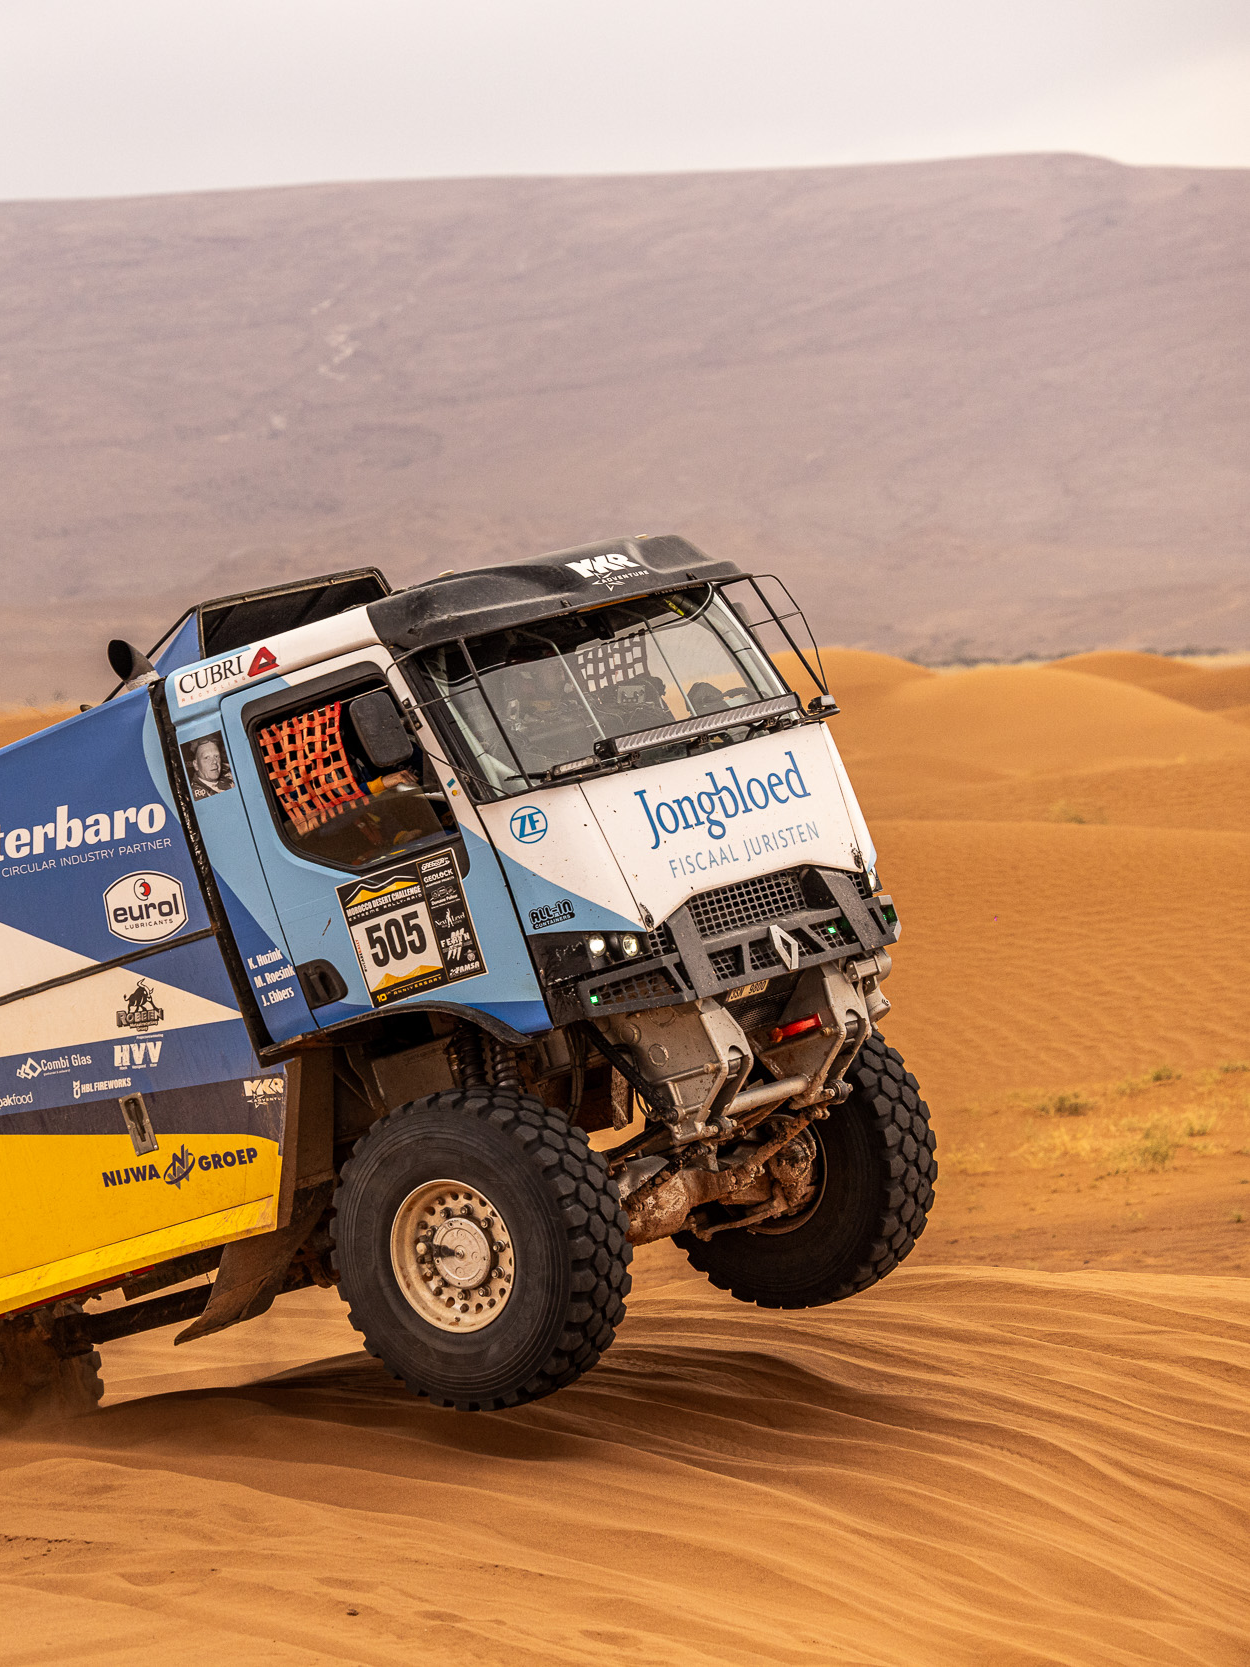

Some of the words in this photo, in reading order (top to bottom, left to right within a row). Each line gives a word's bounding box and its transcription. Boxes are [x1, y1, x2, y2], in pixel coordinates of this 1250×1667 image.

[564, 553, 640, 578] MKR
[602, 570, 650, 584] ADVENTURE
[179, 654, 244, 694] CUBRI
[182, 676, 246, 702] RECYCLING
[634, 751, 812, 850] Jongbloed
[511, 810, 546, 838] ZF
[2, 858, 56, 878] CIRCULAR
[60, 848, 115, 867] INDUSTRY
[118, 838, 172, 856] PARTNER
[668, 844, 739, 878] FISCAAL
[743, 821, 820, 862] JURISTEN
[424, 868, 454, 883] GEOLOCK
[112, 893, 180, 924] eurol
[346, 903, 372, 918] MOROCCO
[372, 895, 392, 910] DESERT
[391, 884, 422, 900] CHALLENGE
[530, 900, 574, 924] ALL-IN
[124, 918, 174, 930] LUBRICANTS
[533, 913, 574, 930] CONTAINERS
[364, 910, 427, 968] 505
[247, 958, 258, 970] K.
[256, 948, 284, 967] Huzink
[254, 976, 266, 988] M.
[264, 964, 296, 984] Roesink
[394, 976, 442, 995] ANNIVERSARY
[261, 994, 270, 1006] J.
[268, 986, 294, 1004] Ebbers
[116, 1008, 164, 1028] ROBEEN
[40, 1056, 70, 1071] Combi
[70, 1054, 92, 1066] Glas
[114, 1041, 162, 1066] HVV
[243, 1078, 284, 1096] MKR
[102, 1164, 161, 1188] NIJWA
[198, 1148, 258, 1171] GROEP
